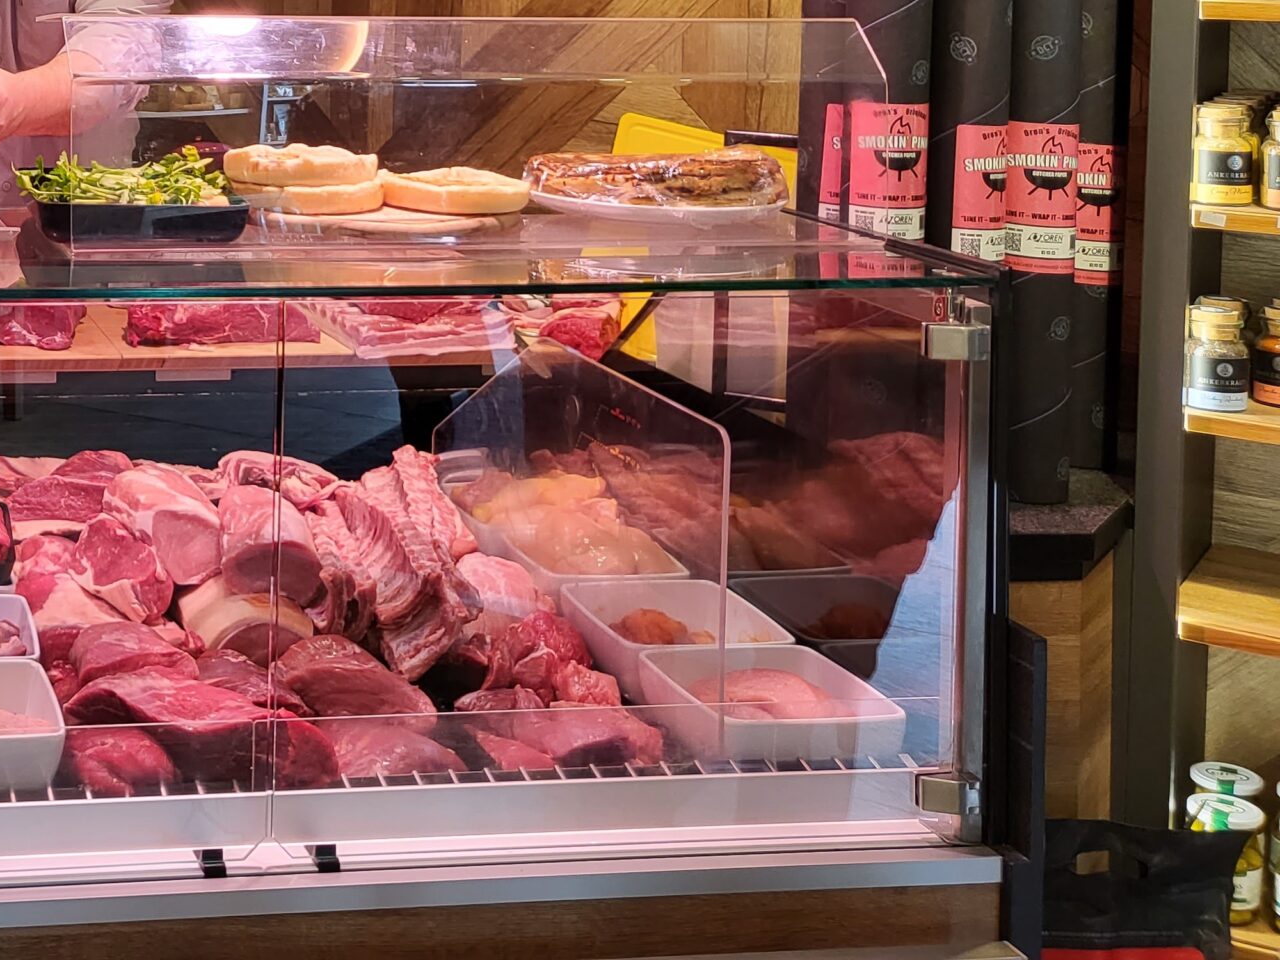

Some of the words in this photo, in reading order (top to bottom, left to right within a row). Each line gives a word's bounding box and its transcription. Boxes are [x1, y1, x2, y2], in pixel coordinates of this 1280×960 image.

[858, 135, 909, 149] SMOKIN'
[1007, 154, 1061, 168] SMOKIN'
[1063, 155, 1077, 169] PIN
[1076, 172, 1108, 186] OKIN'
[1207, 171, 1248, 179] ANKERKRA
